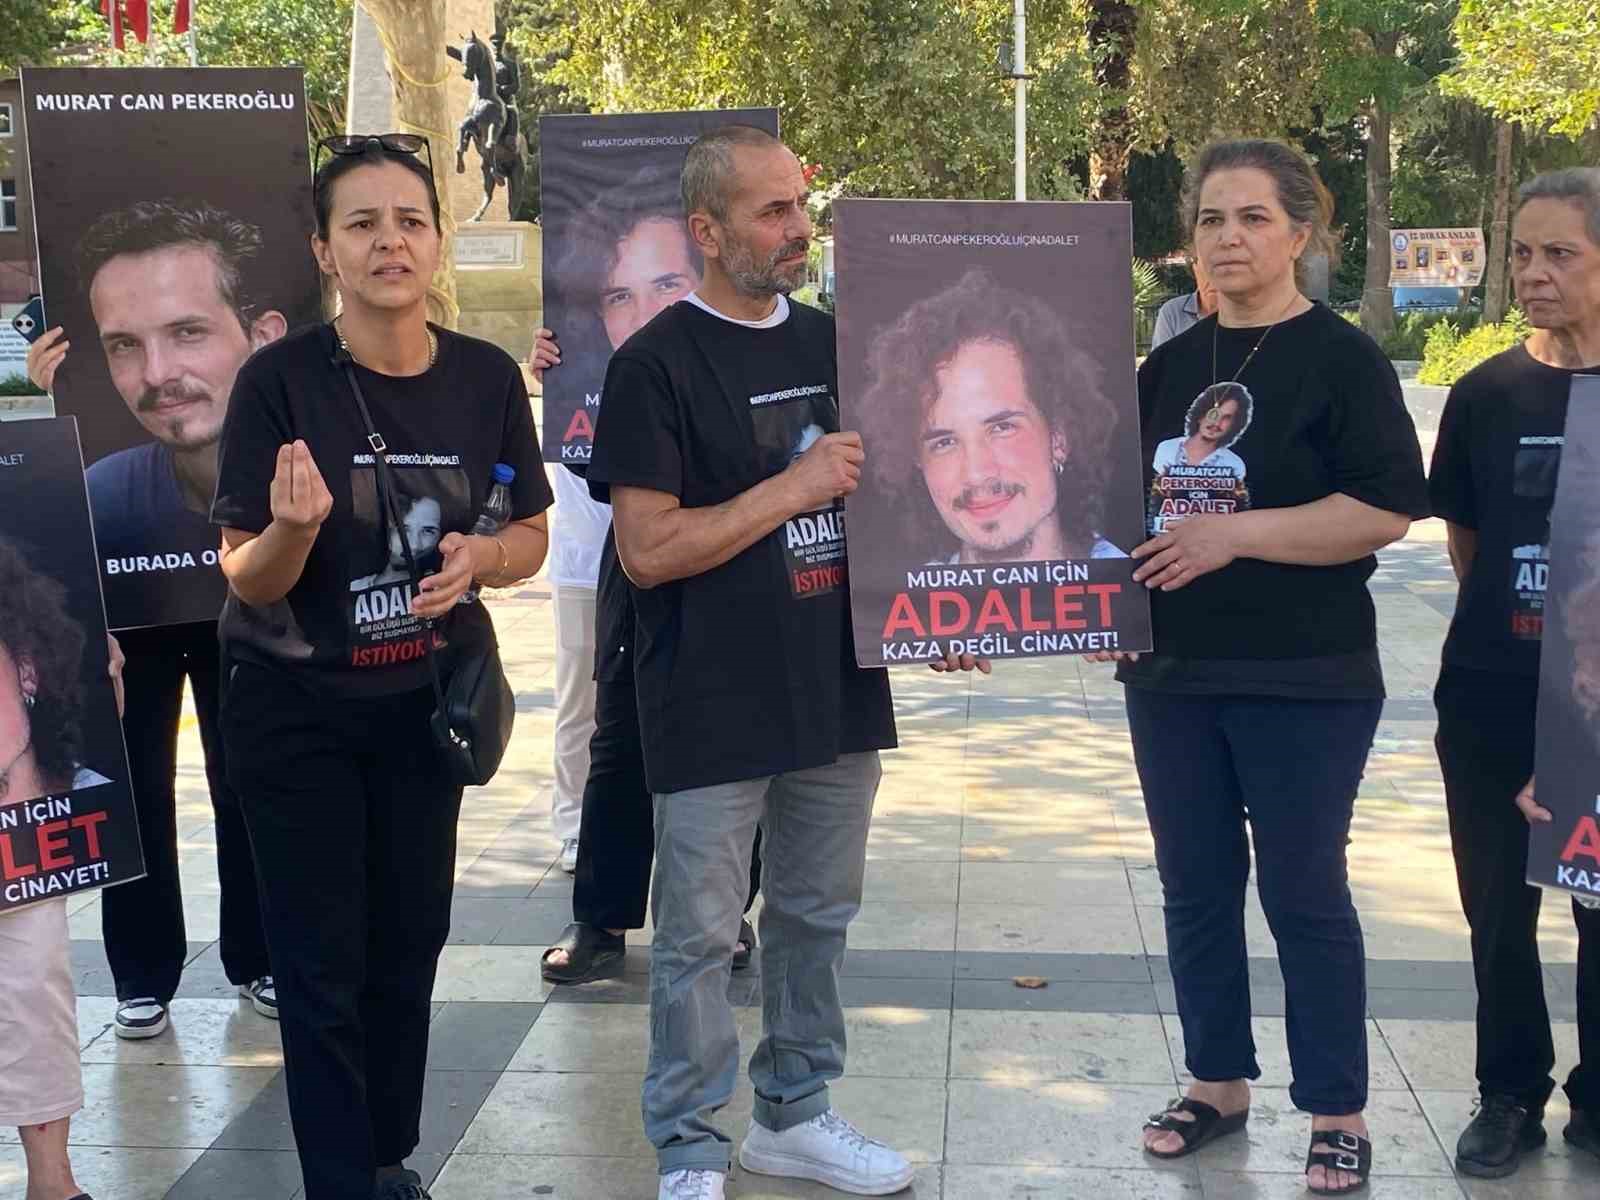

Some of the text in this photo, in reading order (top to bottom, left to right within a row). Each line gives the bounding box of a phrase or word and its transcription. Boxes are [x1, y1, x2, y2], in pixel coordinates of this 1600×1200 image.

[35, 89, 295, 111] MURAT CAN PEKEROĞLU
[561, 445, 593, 459] KAZ
[1168, 466, 1232, 477] MURATCAN
[1160, 498, 1237, 516] ADALET
[785, 511, 846, 549] ADALE
[106, 552, 196, 574] BURADA
[907, 560, 1089, 588] MURAT CAN İÇİN
[355, 584, 414, 625] ADAL
[882, 584, 1122, 639] ADALET
[882, 630, 1118, 660] KAZA DEĞİL CİNAYET!
[24, 796, 72, 826] İÇİN
[5, 861, 109, 902] CİNAYET!
